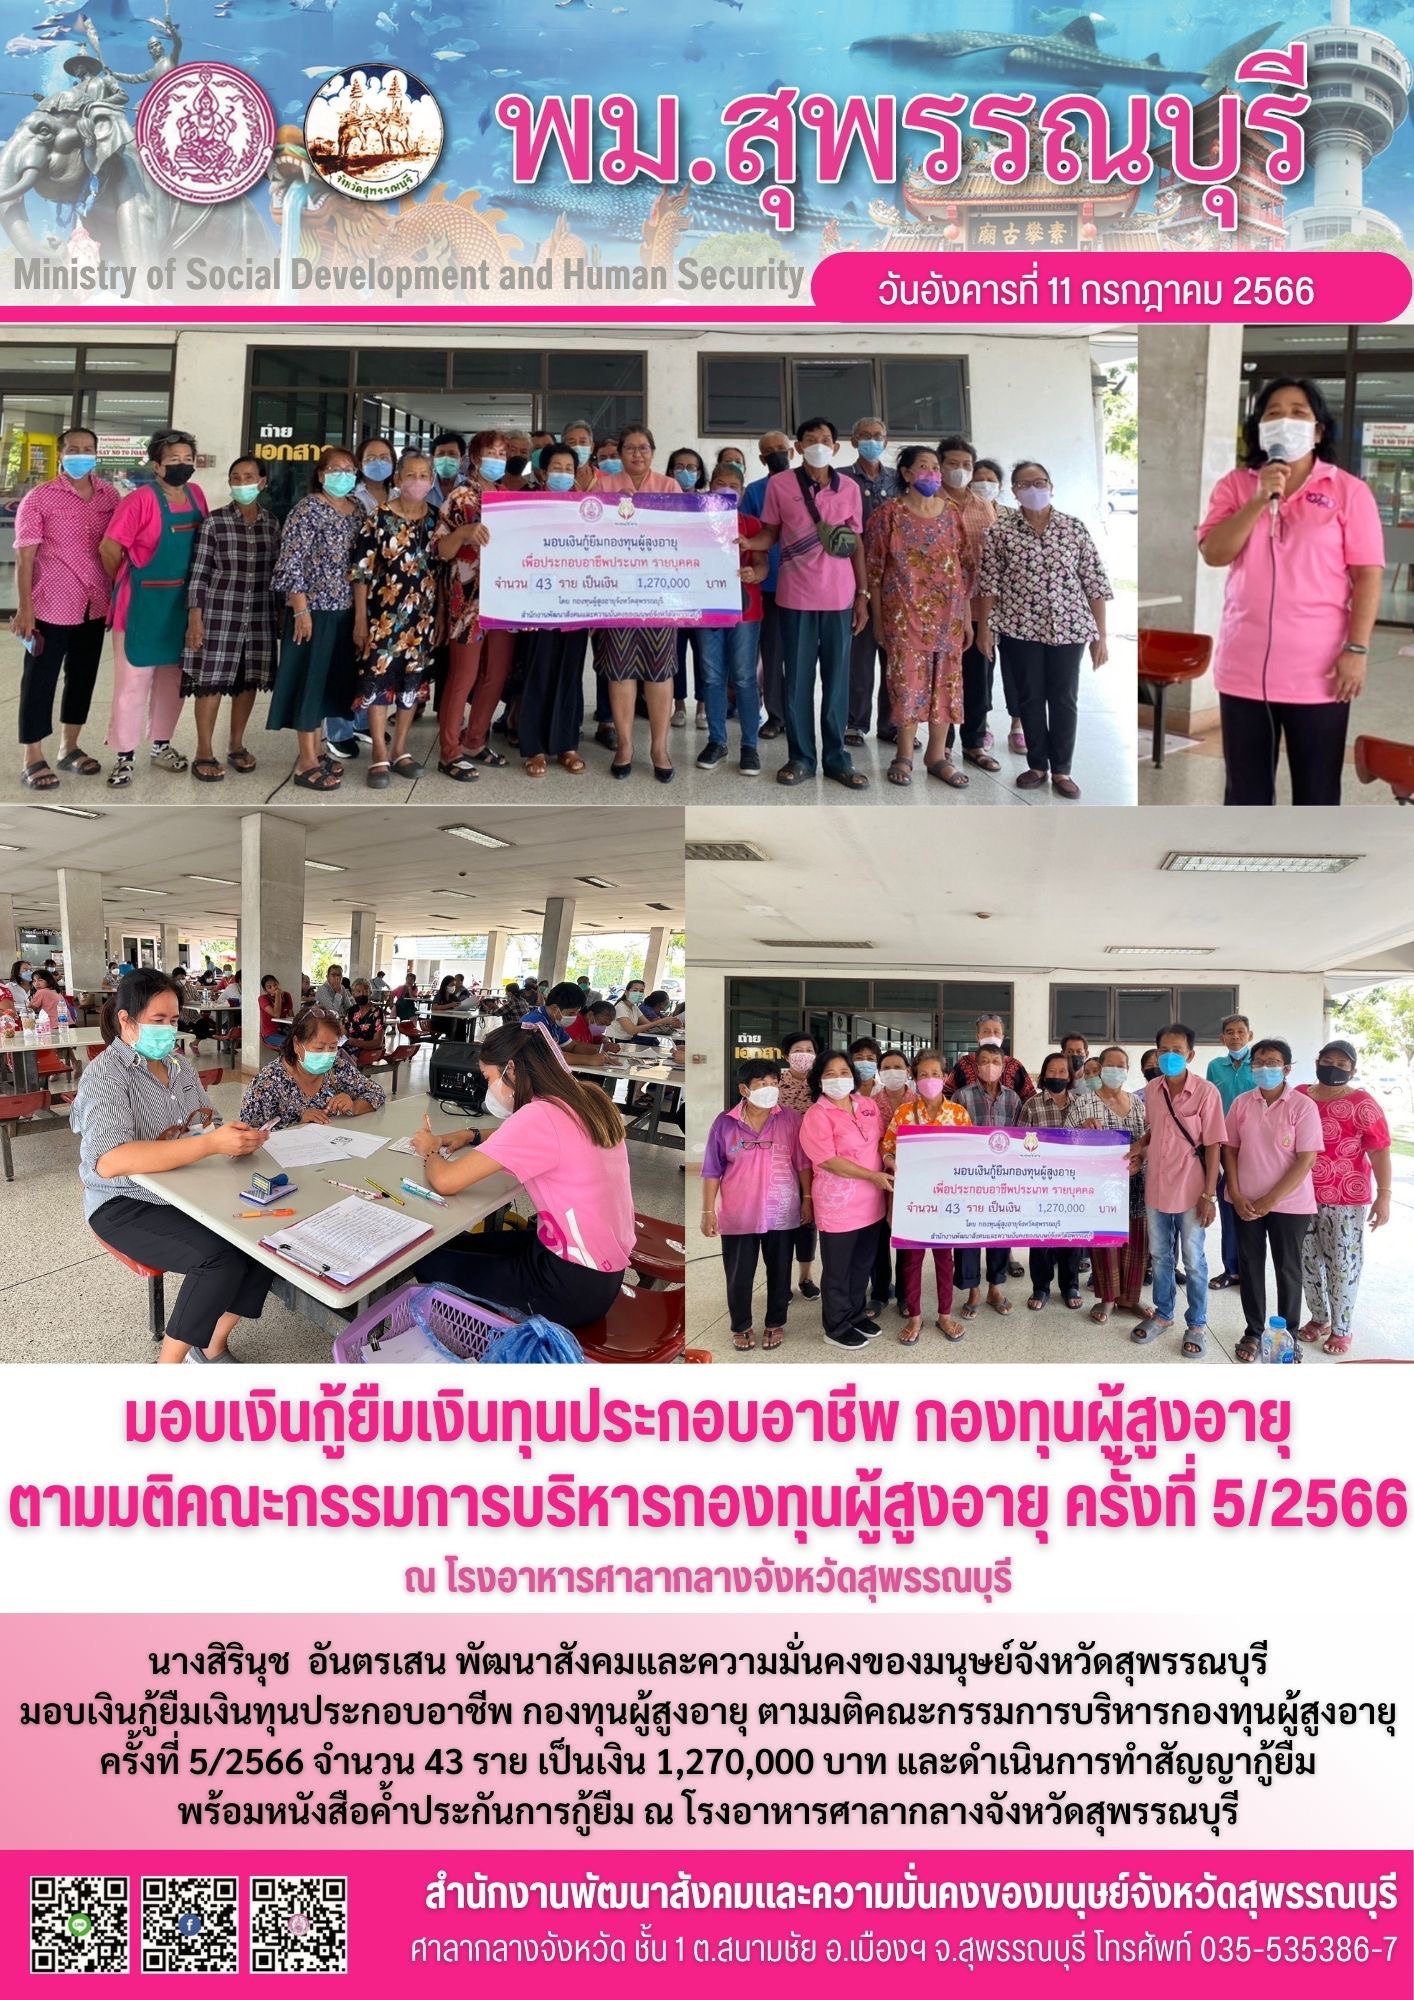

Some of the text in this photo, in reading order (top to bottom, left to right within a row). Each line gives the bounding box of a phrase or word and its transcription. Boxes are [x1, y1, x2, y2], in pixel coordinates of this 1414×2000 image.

[260, 424, 293, 438] ถ่าย
[543, 535, 678, 551] มอบเงินกู้ยืมกองทุนผู้สูงอายุ
[522, 553, 700, 571] เพื่อประกอบอาชีพประเภท รายบุคคล
[495, 574, 727, 590] จำนวน 43 ราย เป็นเงิน 1,270,000 บาท
[738, 1033, 762, 1043] ถ่าย
[735, 1047, 784, 1060] เอกสา
[953, 1165, 1076, 1180] มอบเงินกู้ยืมกองทุนผู้สูงอายุ
[933, 1180, 1094, 1198] เพื่อประกอบอาชีพประเภท รายบุคคล
[906, 1200, 1117, 1214] จำนวน 43 ราย เป็นเงิน 1,270,000 บาท
